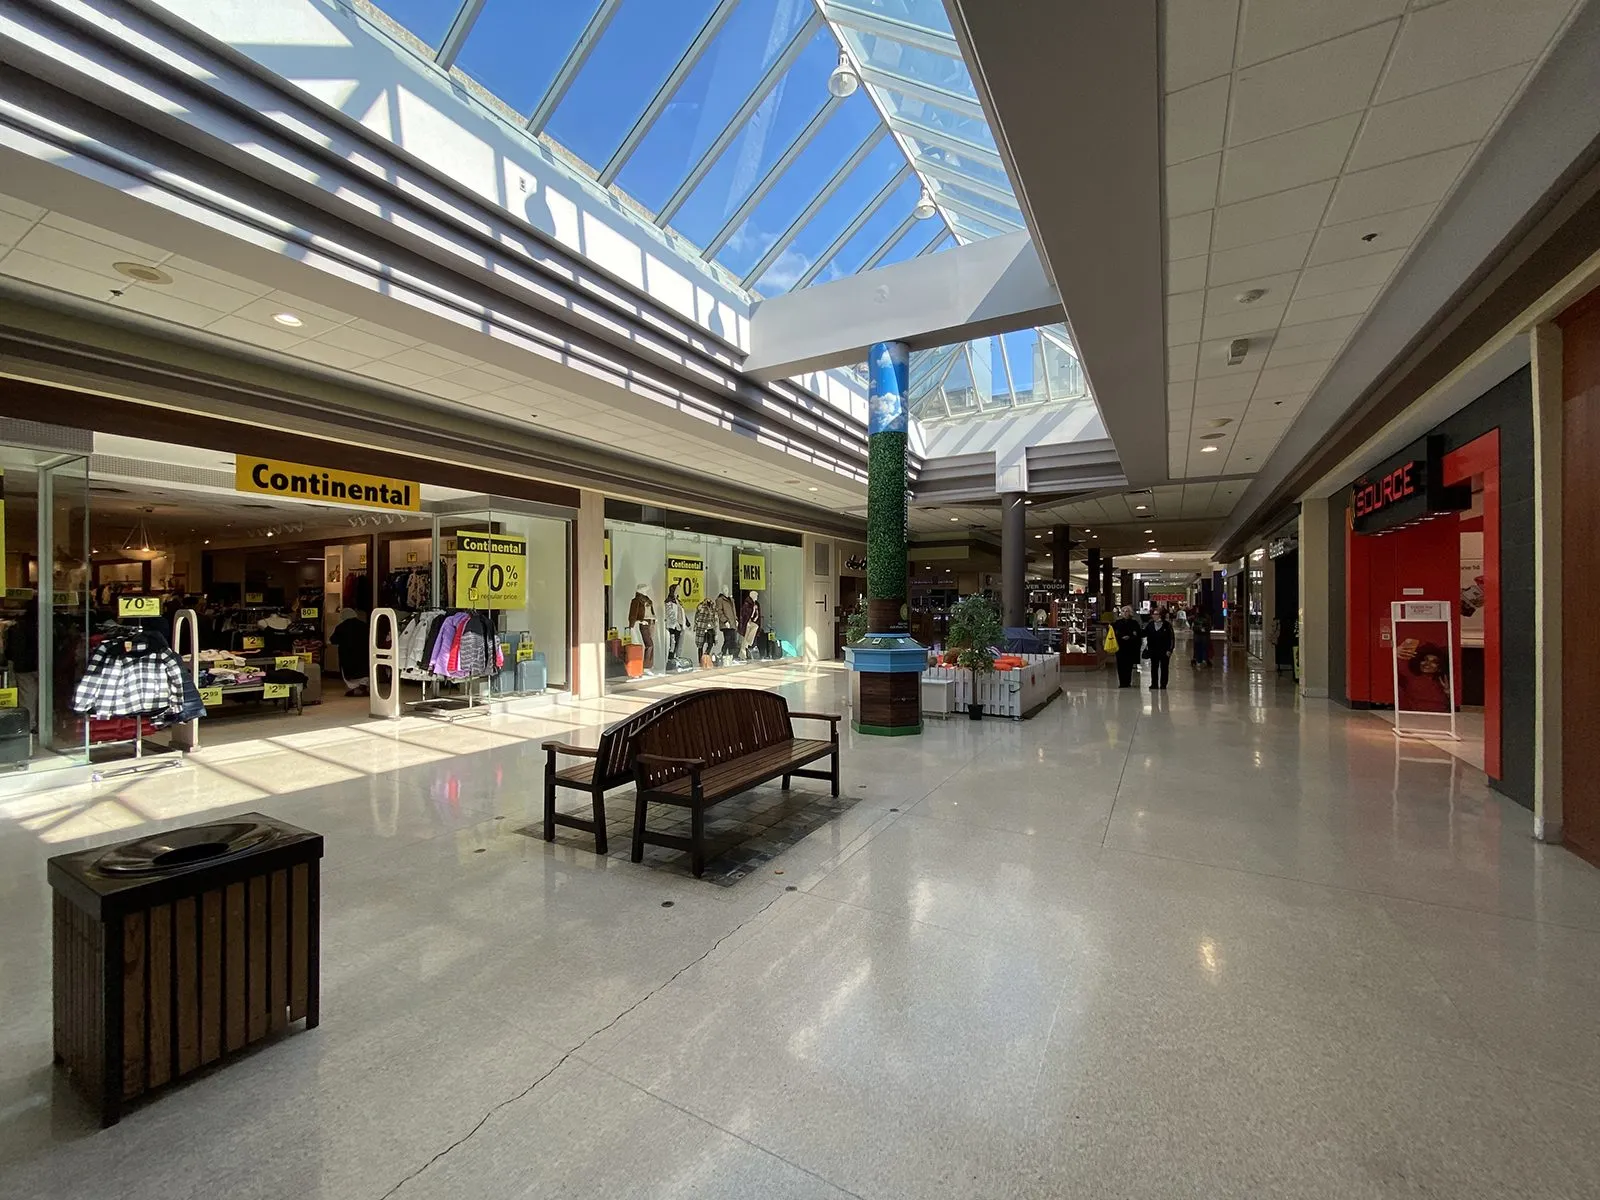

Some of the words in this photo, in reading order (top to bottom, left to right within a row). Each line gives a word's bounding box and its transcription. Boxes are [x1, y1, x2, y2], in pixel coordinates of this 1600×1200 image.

[252, 463, 410, 506] Continental
[1356, 461, 1414, 518] SOURCE
[463, 538, 521, 554] Continental
[671, 559, 701, 570] Continental
[743, 564, 761, 581] MEN
[503, 593, 518, 601] price
